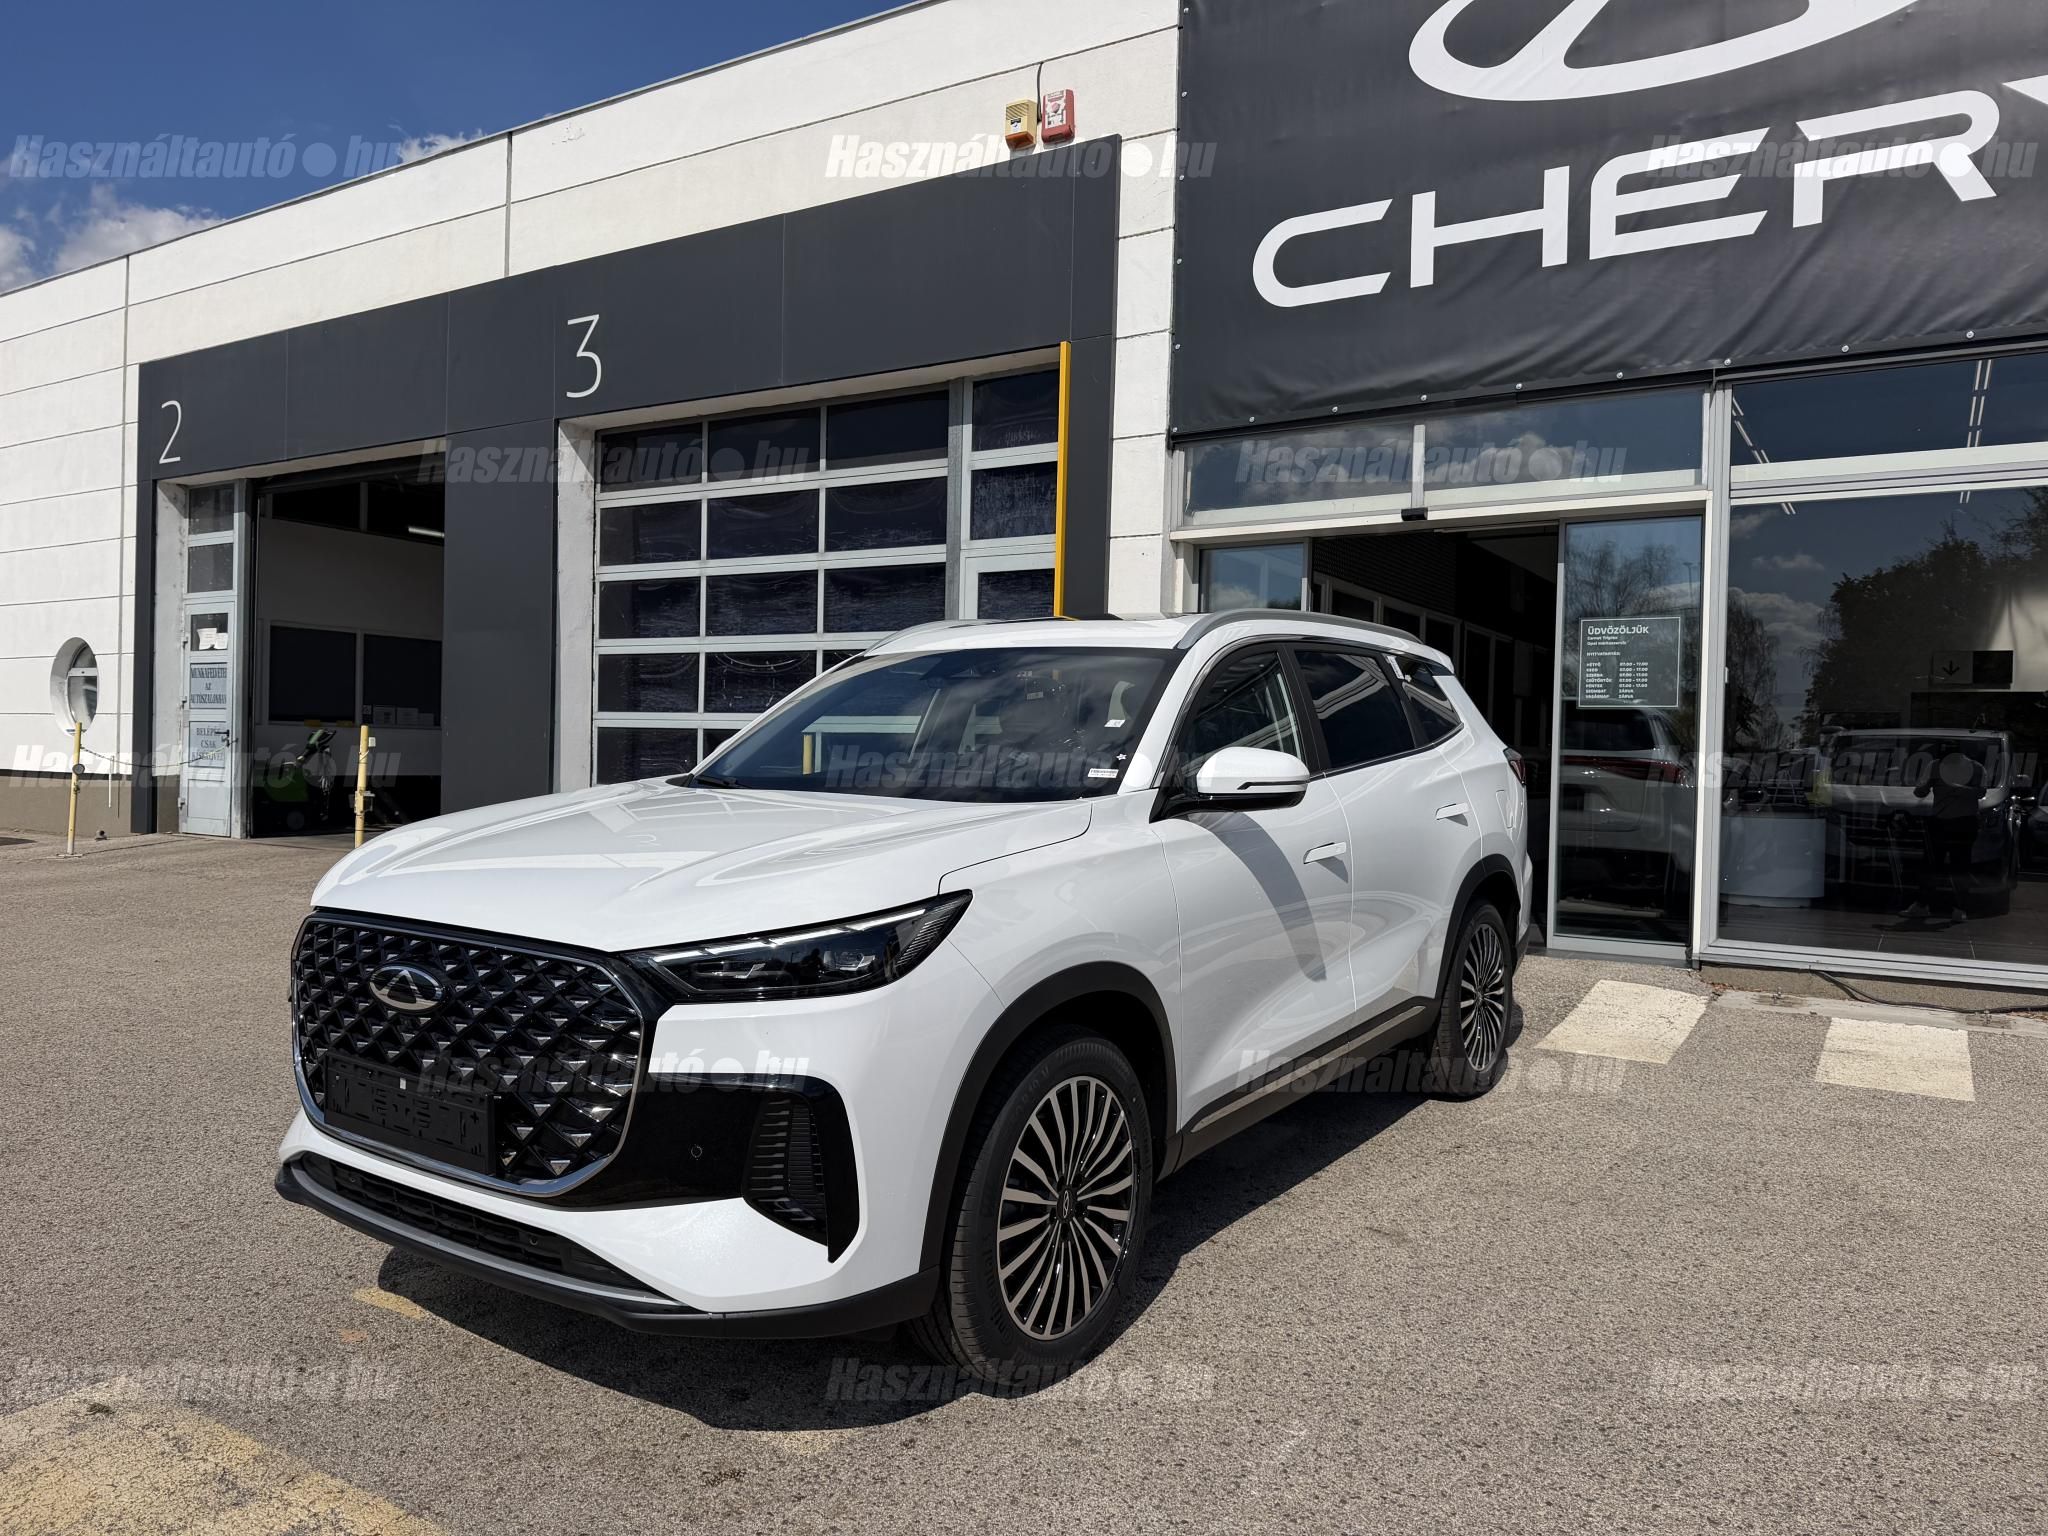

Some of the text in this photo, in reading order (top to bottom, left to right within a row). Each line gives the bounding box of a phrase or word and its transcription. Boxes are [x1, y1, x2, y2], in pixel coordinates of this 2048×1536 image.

[1252, 75, 2048, 308] CHER
[565, 314, 603, 398] 3
[158, 400, 182, 464] 2
[1587, 625, 1649, 635] ÜDVÖZÖLJÜK
